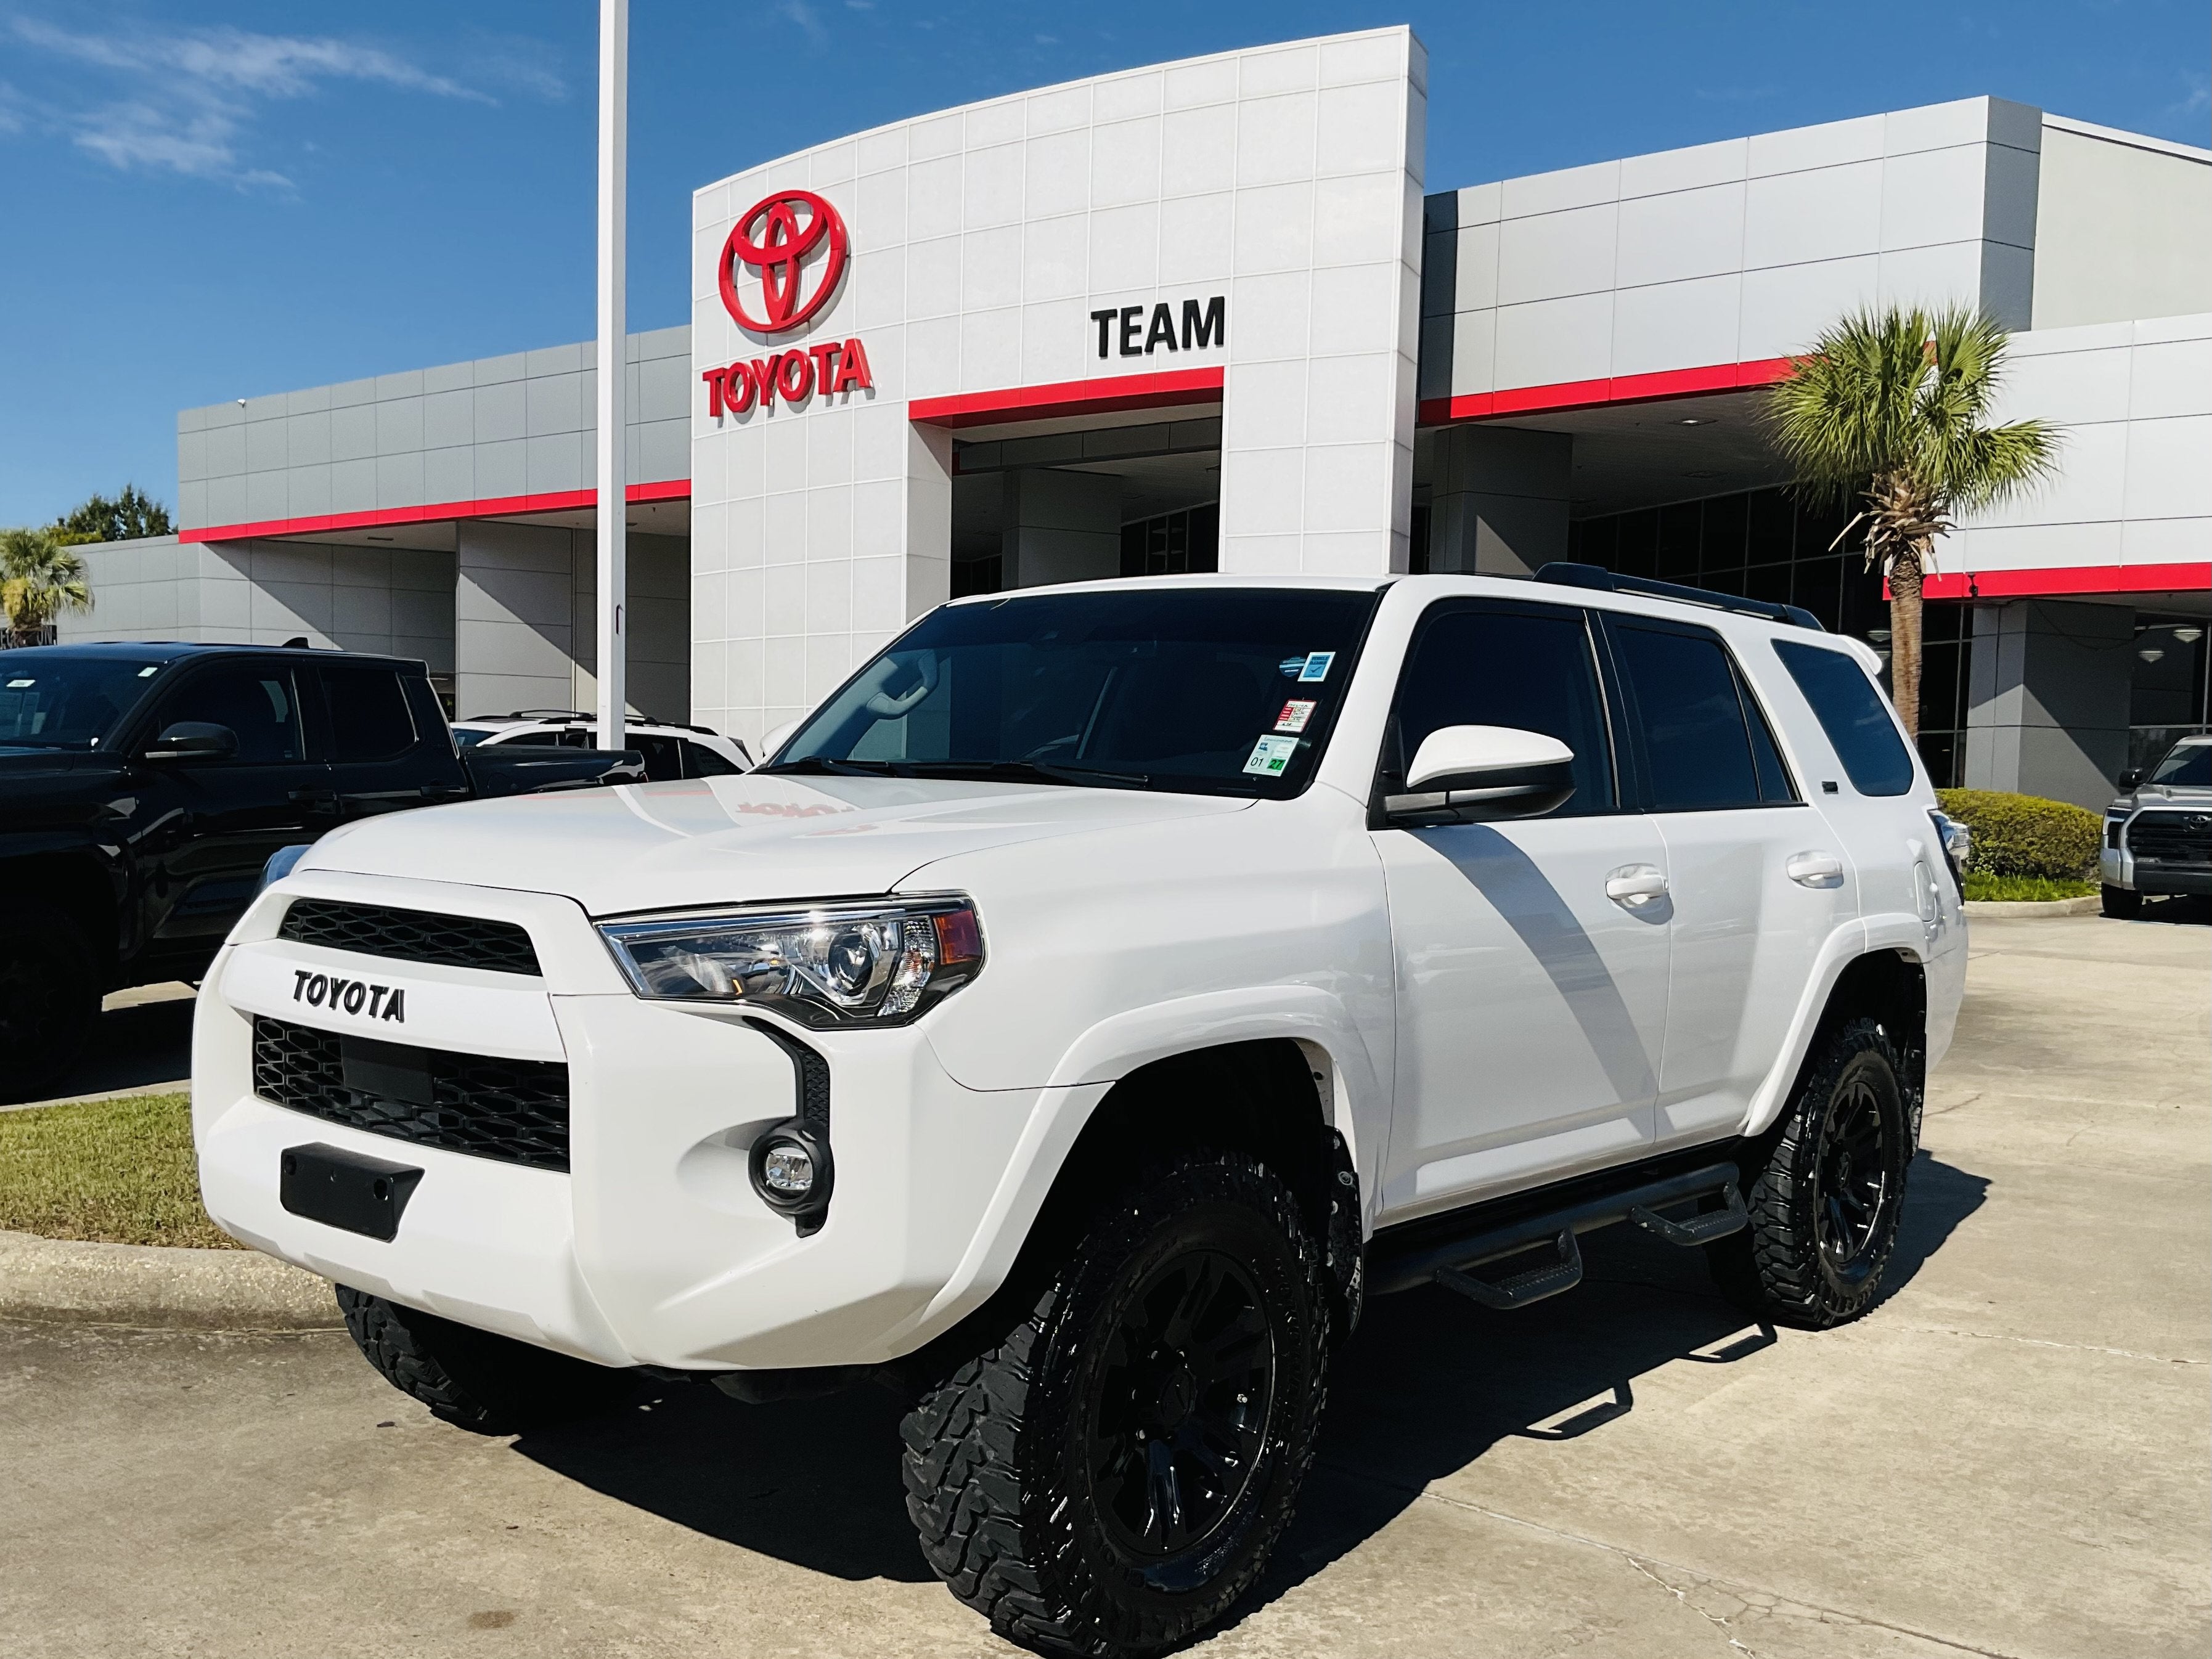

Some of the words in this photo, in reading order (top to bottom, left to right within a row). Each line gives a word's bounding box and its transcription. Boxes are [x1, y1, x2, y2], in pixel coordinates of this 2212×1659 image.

[1090, 296, 1225, 358] TEAM
[703, 338, 871, 417] TOYOTA
[1250, 757, 1264, 767] 01
[1267, 759, 1284, 770] 27
[293, 969, 405, 1023] TOYOTA
